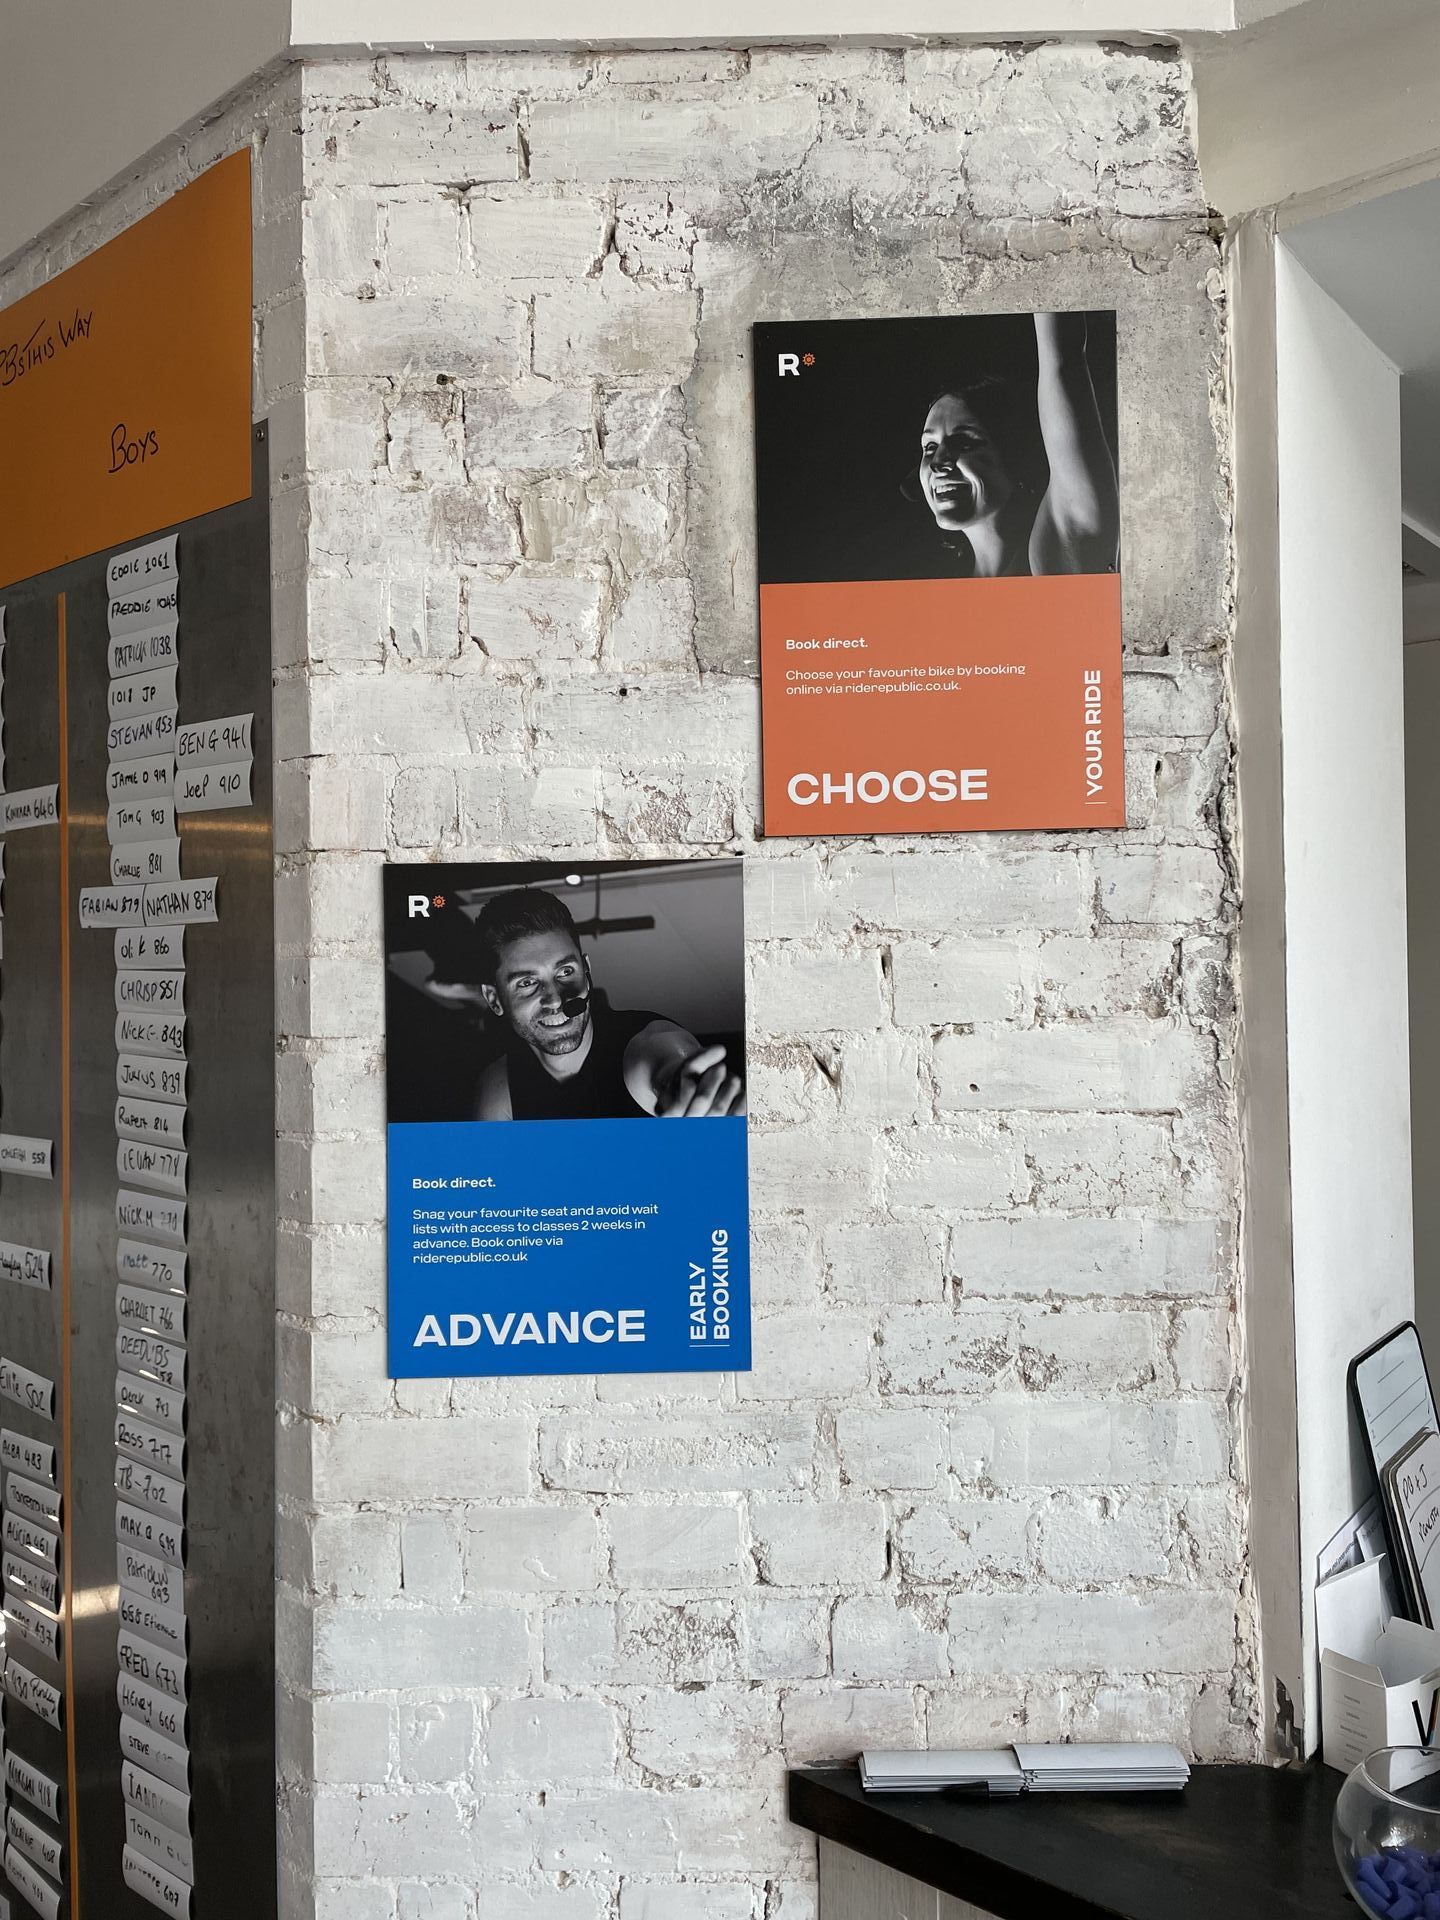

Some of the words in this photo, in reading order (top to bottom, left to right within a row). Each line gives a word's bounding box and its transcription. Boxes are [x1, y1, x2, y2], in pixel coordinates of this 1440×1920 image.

[58, 308, 93, 348] WAY
[145, 551, 170, 574] 1061
[114, 640, 147, 669] PATRICK
[150, 635, 173, 658] 1038
[785, 638, 820, 651] Book
[823, 636, 869, 650] direct.
[785, 668, 834, 681] Choose
[836, 668, 866, 680] your
[868, 665, 927, 679] favourite
[928, 664, 955, 677] bike
[956, 664, 973, 678] by
[974, 663, 1026, 676] booking
[142, 686, 156, 702] JP
[785, 683, 823, 696] online
[824, 683, 844, 695] via
[844, 680, 962, 695] riderepublic.co.uk.
[1084, 669, 1102, 726] RIDE
[107, 720, 153, 749] STEVAN
[155, 715, 172, 738] 953
[178, 731, 205, 756] BEN
[1084, 728, 1104, 798] YOUR
[154, 768, 167, 784] 919
[219, 773, 241, 794] 910
[786, 767, 989, 806] CHOOSE
[33, 795, 55, 819] 646
[151, 809, 165, 825] 903
[148, 852, 163, 874] 881
[81, 897, 119, 917] FABIAN
[146, 891, 190, 917] NATHAN
[193, 890, 214, 912] 879
[154, 936, 170, 955] 860
[161, 1025, 183, 1048] 843
[162, 1070, 180, 1095] 839
[154, 1116, 169, 1134] 814
[411, 1177, 448, 1190] Book
[449, 1176, 497, 1189] direct.
[412, 1208, 445, 1221] Snag
[446, 1208, 478, 1221] your
[480, 1206, 539, 1219] favourite
[540, 1206, 568, 1218] seat
[569, 1205, 595, 1217] and
[595, 1204, 630, 1216] avoid
[631, 1203, 659, 1216] wait
[412, 1223, 438, 1235] lists
[439, 1222, 468, 1234] with
[470, 1222, 515, 1233] access
[516, 1221, 530, 1232] to
[531, 1219, 580, 1232] classes
[580, 1219, 590, 1231] 2
[590, 1219, 633, 1231] weeks
[634, 1218, 647, 1230] in
[412, 1237, 470, 1250] advance.
[471, 1236, 505, 1248] Book
[506, 1235, 544, 1248] onlive
[545, 1235, 564, 1247] via
[412, 1250, 529, 1265] riderepublic.co.uk
[151, 1262, 173, 1283] 770
[710, 1228, 731, 1341] BOOKING
[688, 1261, 708, 1341] EARLY
[411, 1308, 647, 1348] ADVANCE
